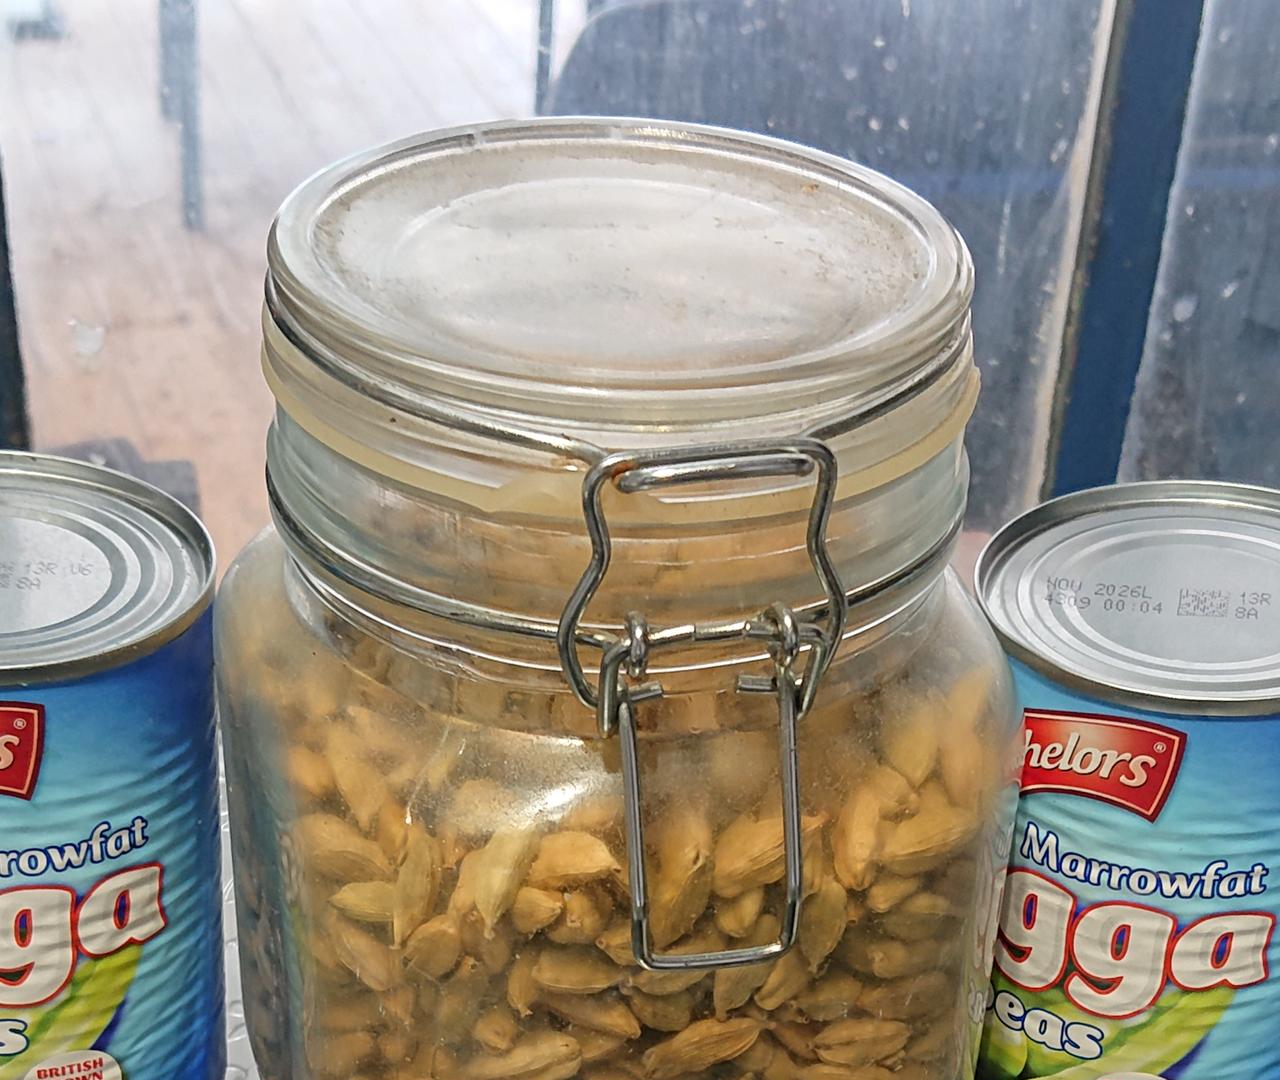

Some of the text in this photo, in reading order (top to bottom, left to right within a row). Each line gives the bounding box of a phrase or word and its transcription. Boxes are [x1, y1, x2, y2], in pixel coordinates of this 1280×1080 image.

[1094, 583, 1152, 600] 2026L
[1239, 592, 1271, 606] 13R
[1235, 606, 1258, 619] 8A
[1019, 822, 1270, 900] Marrowfat
[987, 985, 1105, 1061] eas
[36, 1057, 104, 1080] BRITISH
